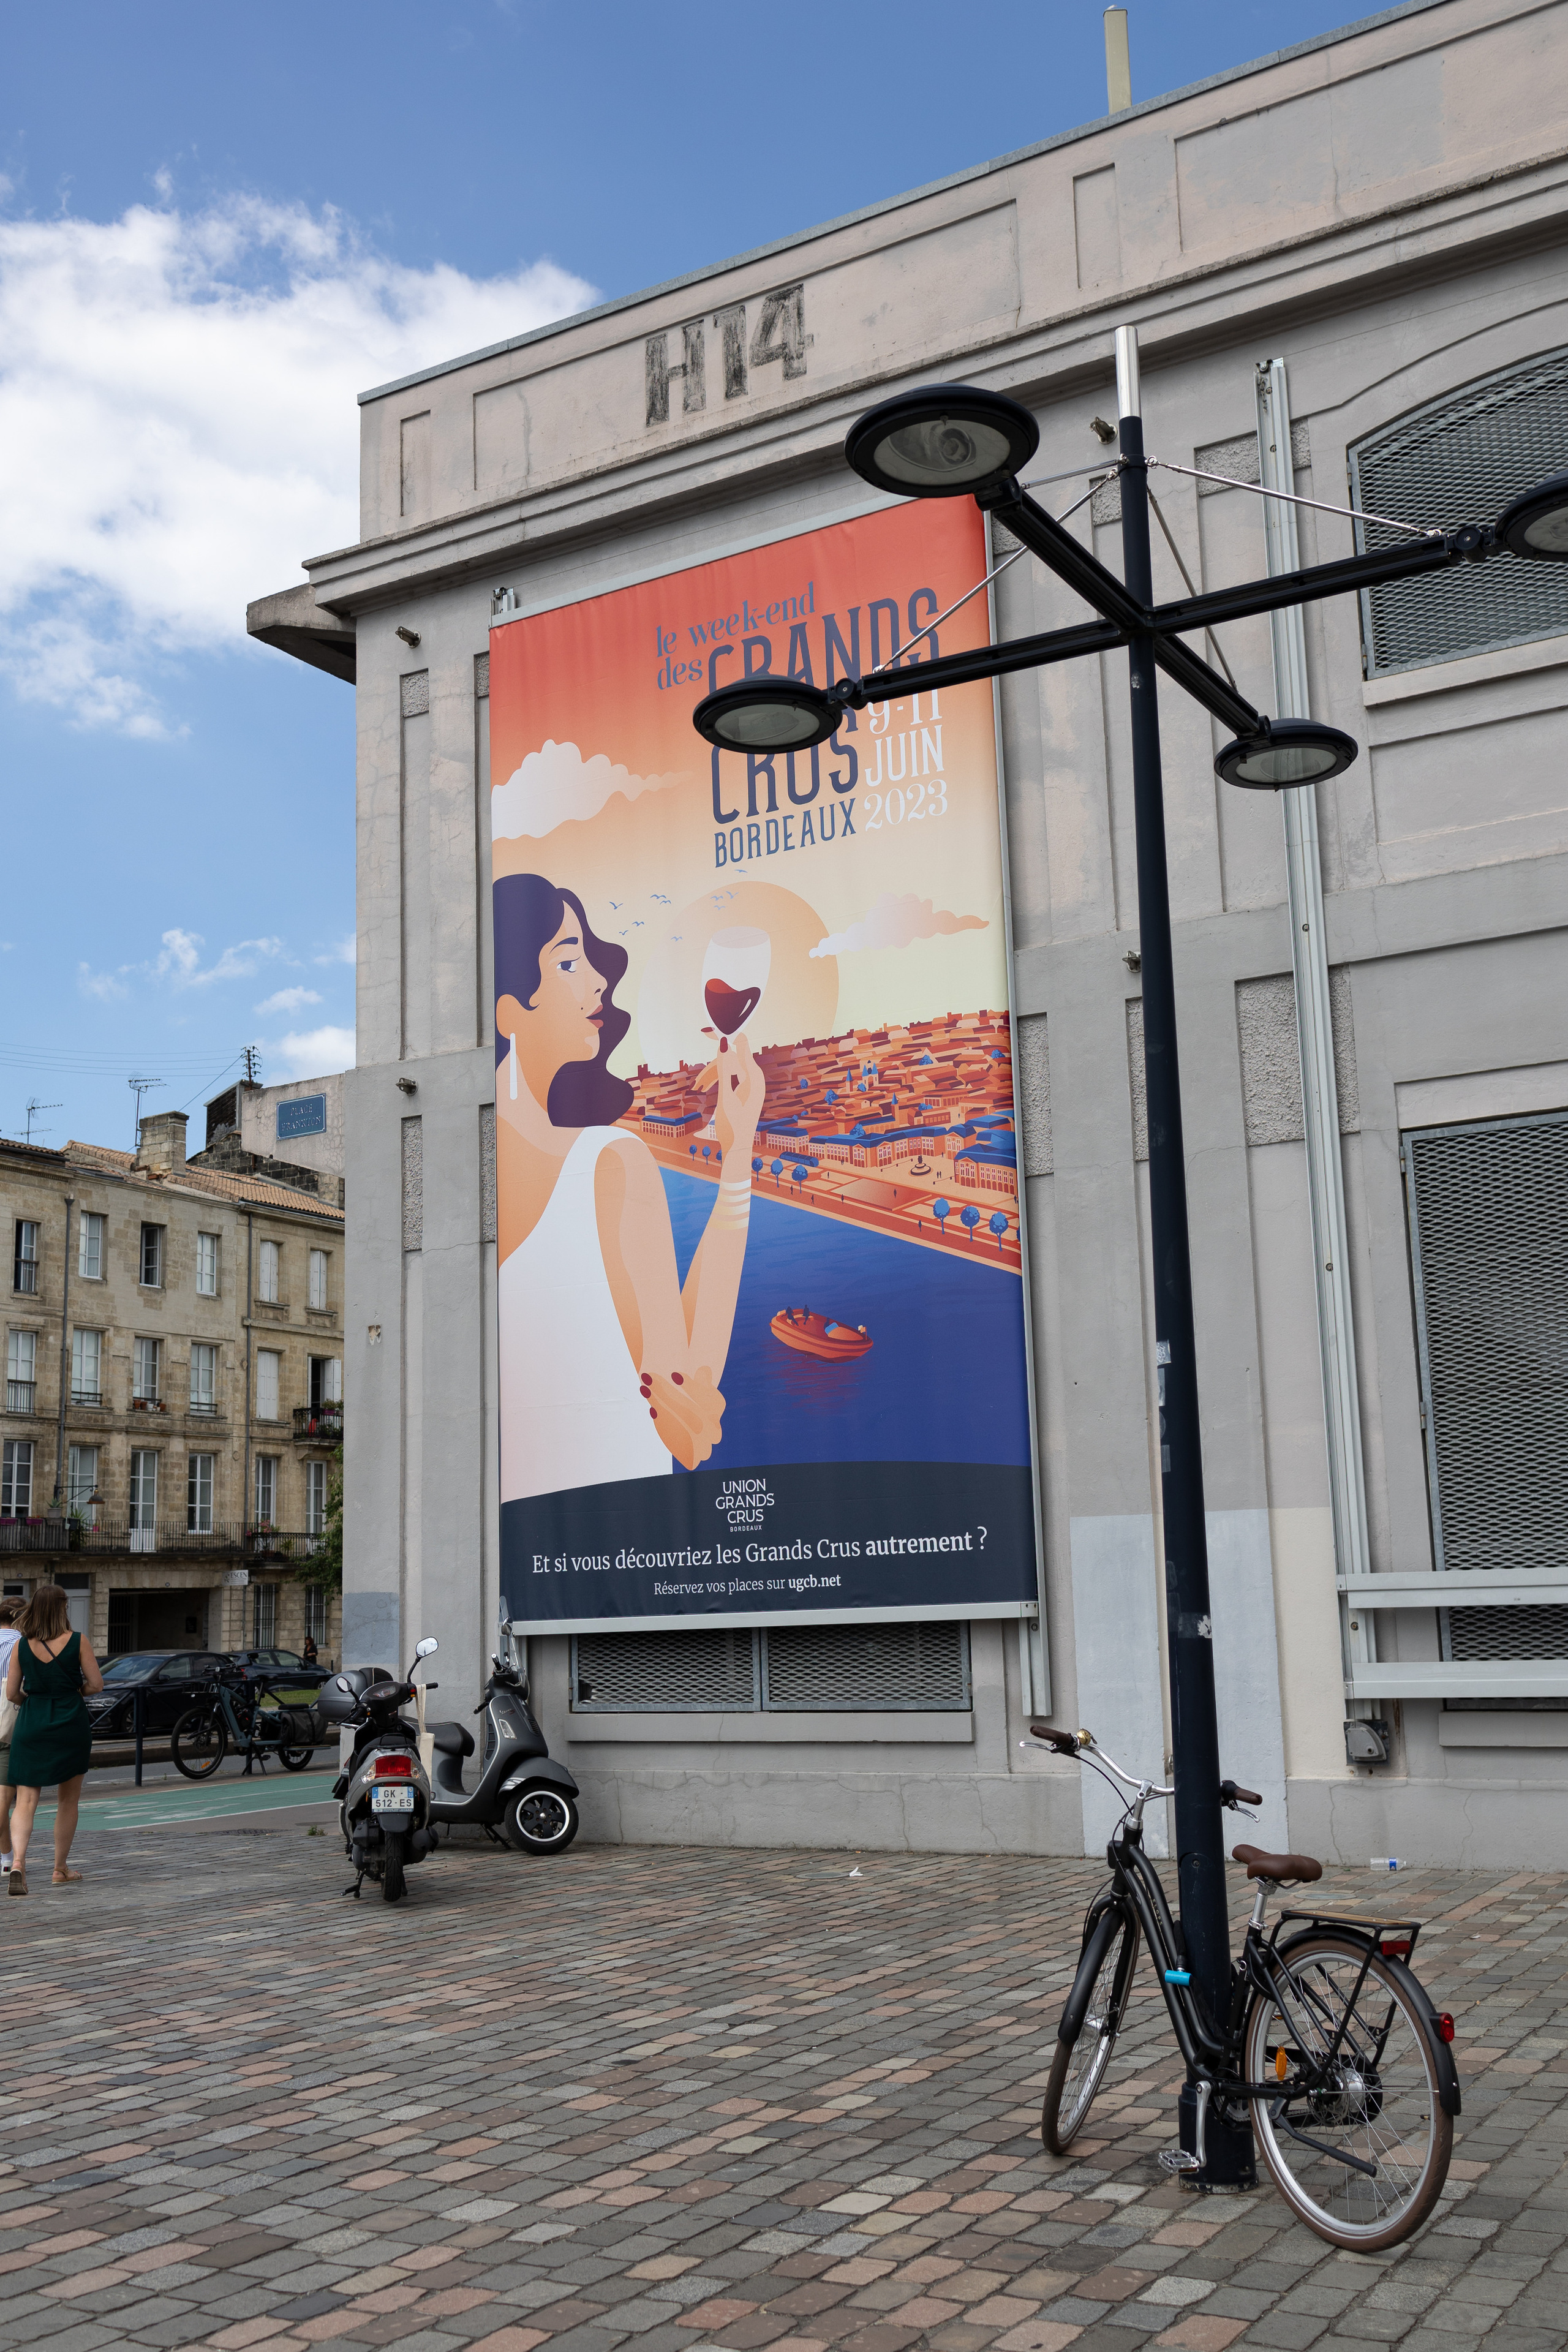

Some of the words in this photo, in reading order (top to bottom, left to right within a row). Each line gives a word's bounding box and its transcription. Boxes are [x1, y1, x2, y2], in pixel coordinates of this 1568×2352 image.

[644, 283, 815, 428] H14
[655, 625, 677, 658] le
[688, 581, 816, 648] week-end
[657, 657, 703, 690] des
[711, 706, 859, 824] CRUS
[864, 725, 944, 787] JUIN
[864, 779, 948, 832] 2023
[714, 797, 857, 868] BORDEAUX
[281, 1116, 322, 1131] FRANKTON
[290, 1104, 313, 1116] PLACE
[715, 1493, 775, 1509] GRANDS
[723, 1478, 766, 1494] UNION
[727, 1509, 764, 1523] CRUS
[532, 1555, 550, 1573] Et
[554, 1553, 568, 1572] si
[571, 1555, 611, 1572] vous
[615, 1547, 712, 1569] découvriez
[715, 1544, 741, 1564] les
[745, 1539, 813, 1562] Grands
[816, 1539, 861, 1559] Crus
[865, 1531, 973, 1556] autrement
[654, 1581, 704, 1595] Réservez
[706, 1581, 726, 1593] vos
[728, 1578, 764, 1595] places
[766, 1577, 786, 1591] sur
[788, 1574, 842, 1592] ugcb.net
